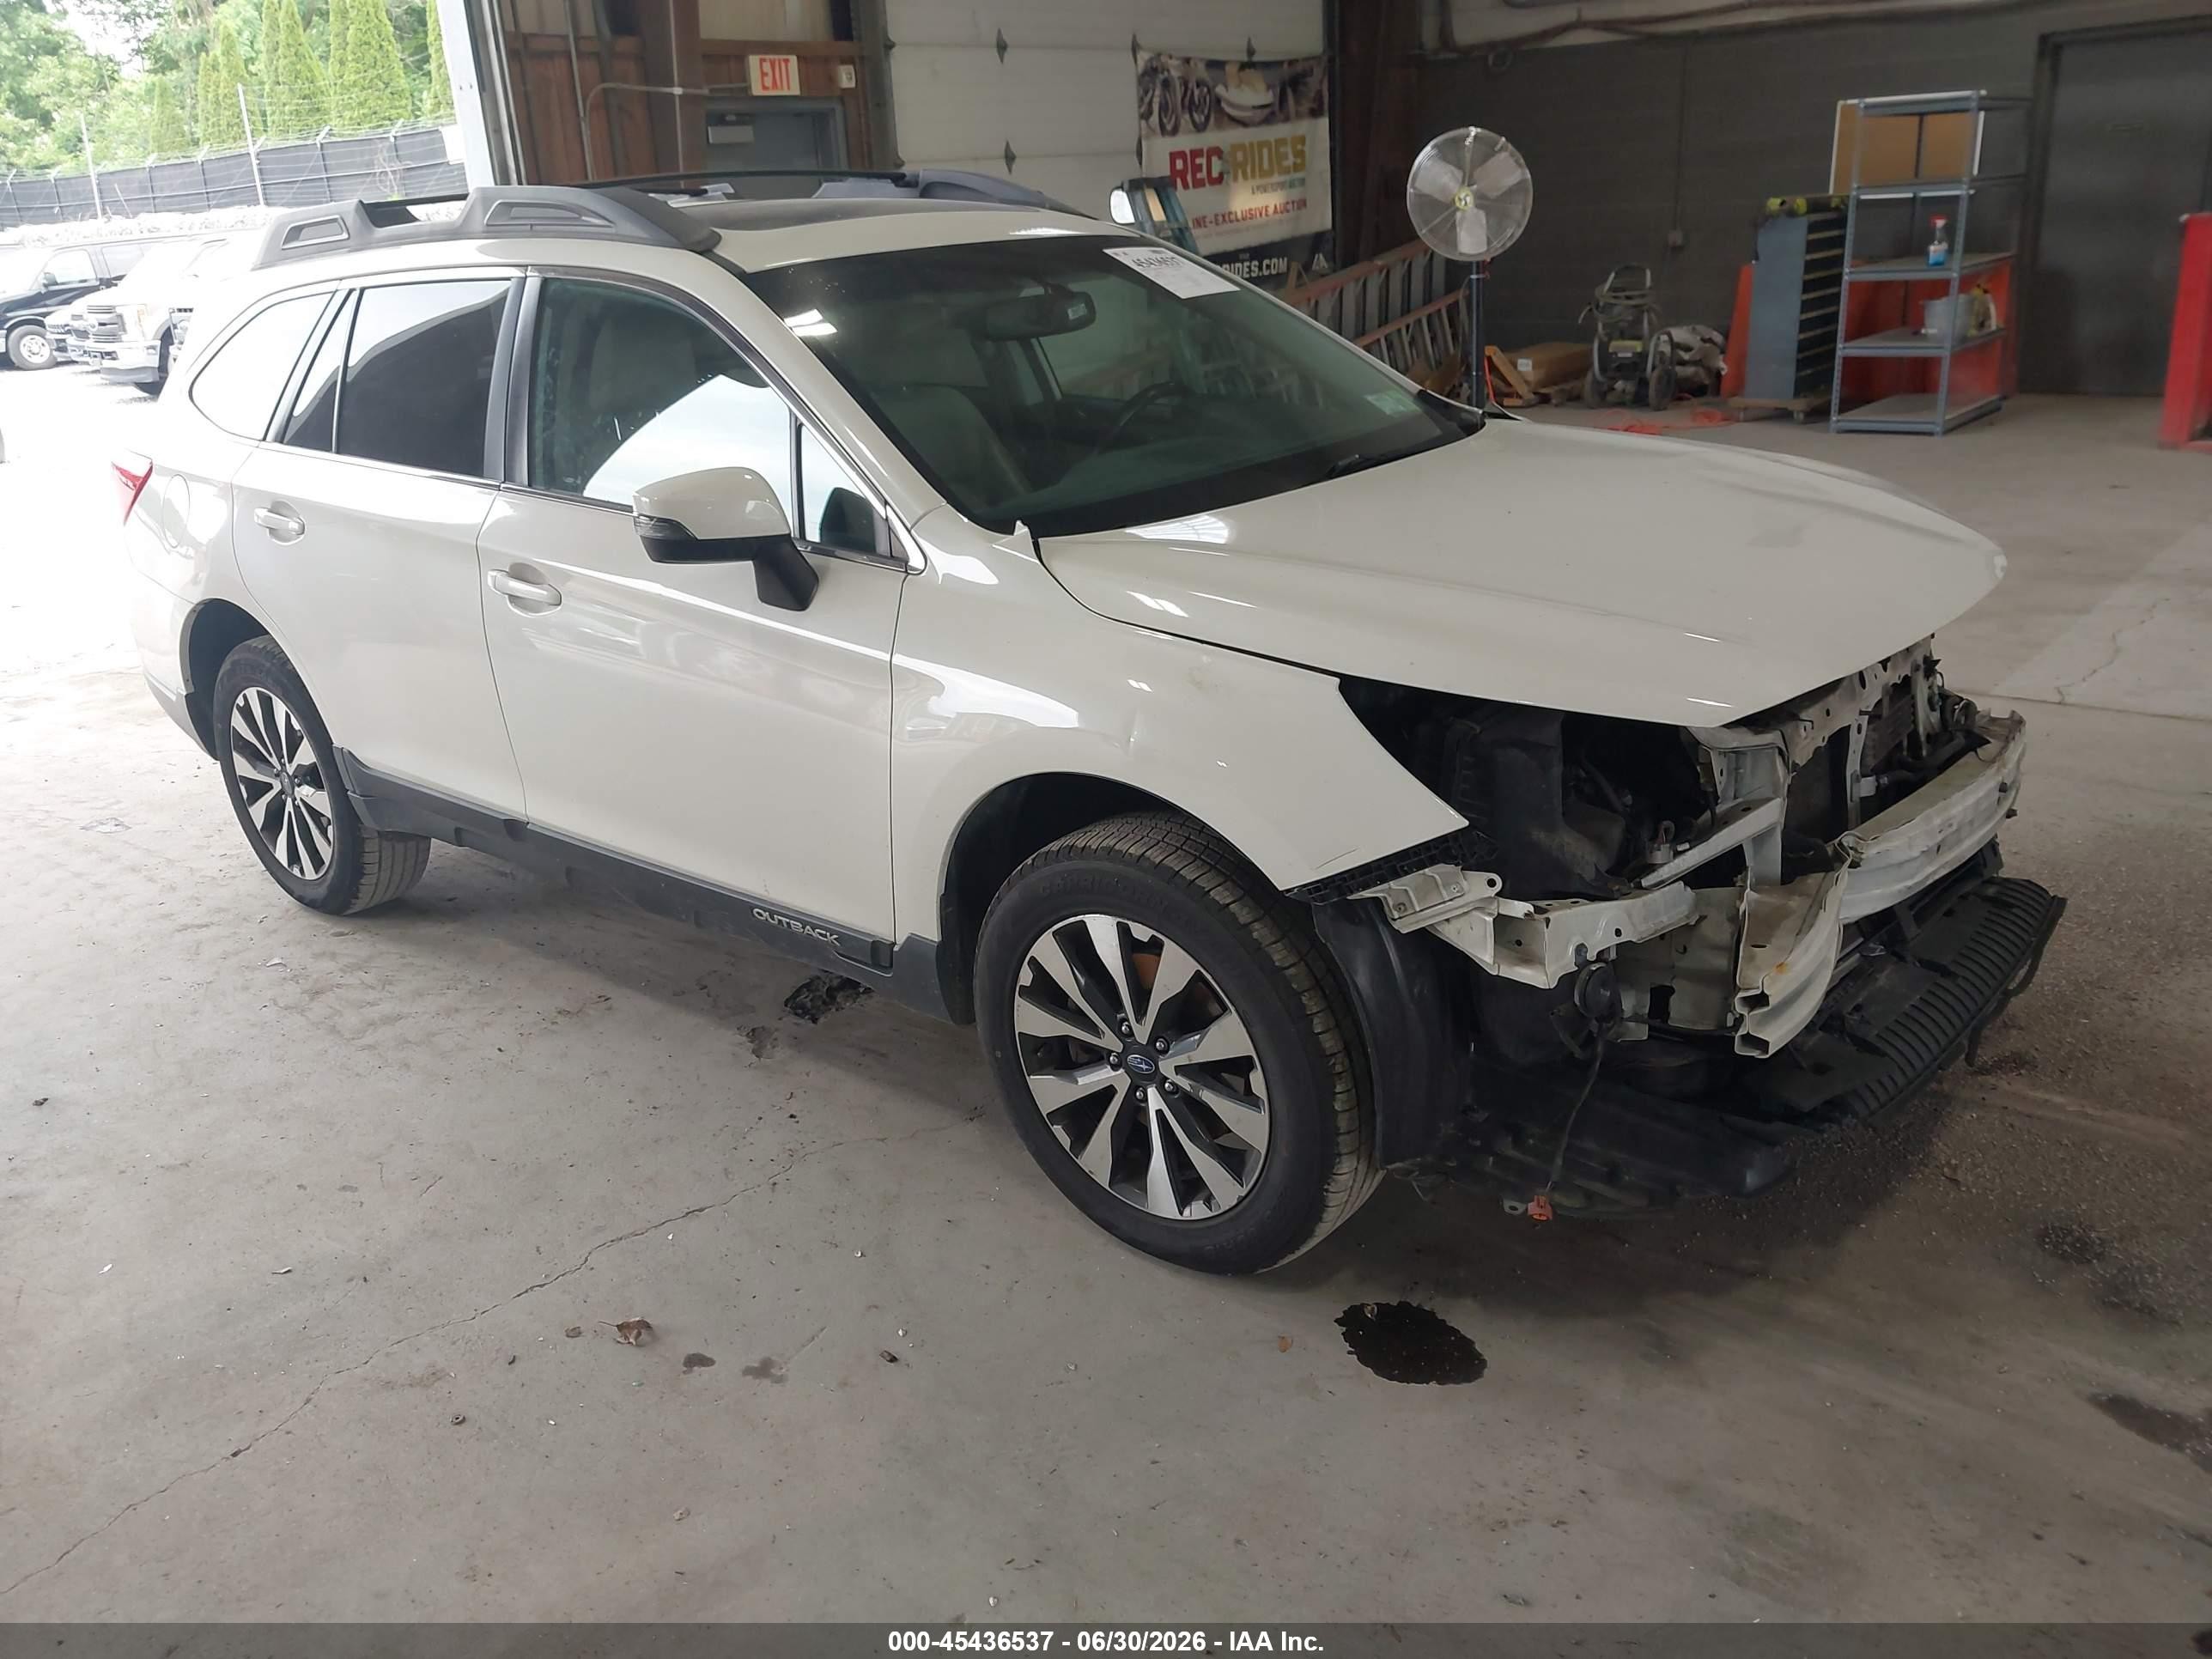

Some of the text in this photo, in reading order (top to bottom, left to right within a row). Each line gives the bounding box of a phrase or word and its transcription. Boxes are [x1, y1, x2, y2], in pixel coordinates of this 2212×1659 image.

[758, 58, 791, 92] EXIT
[1169, 135, 1306, 191] REC RIDES
[1273, 197, 1308, 216] AUCTION
[752, 908, 842, 946] OUTBACK
